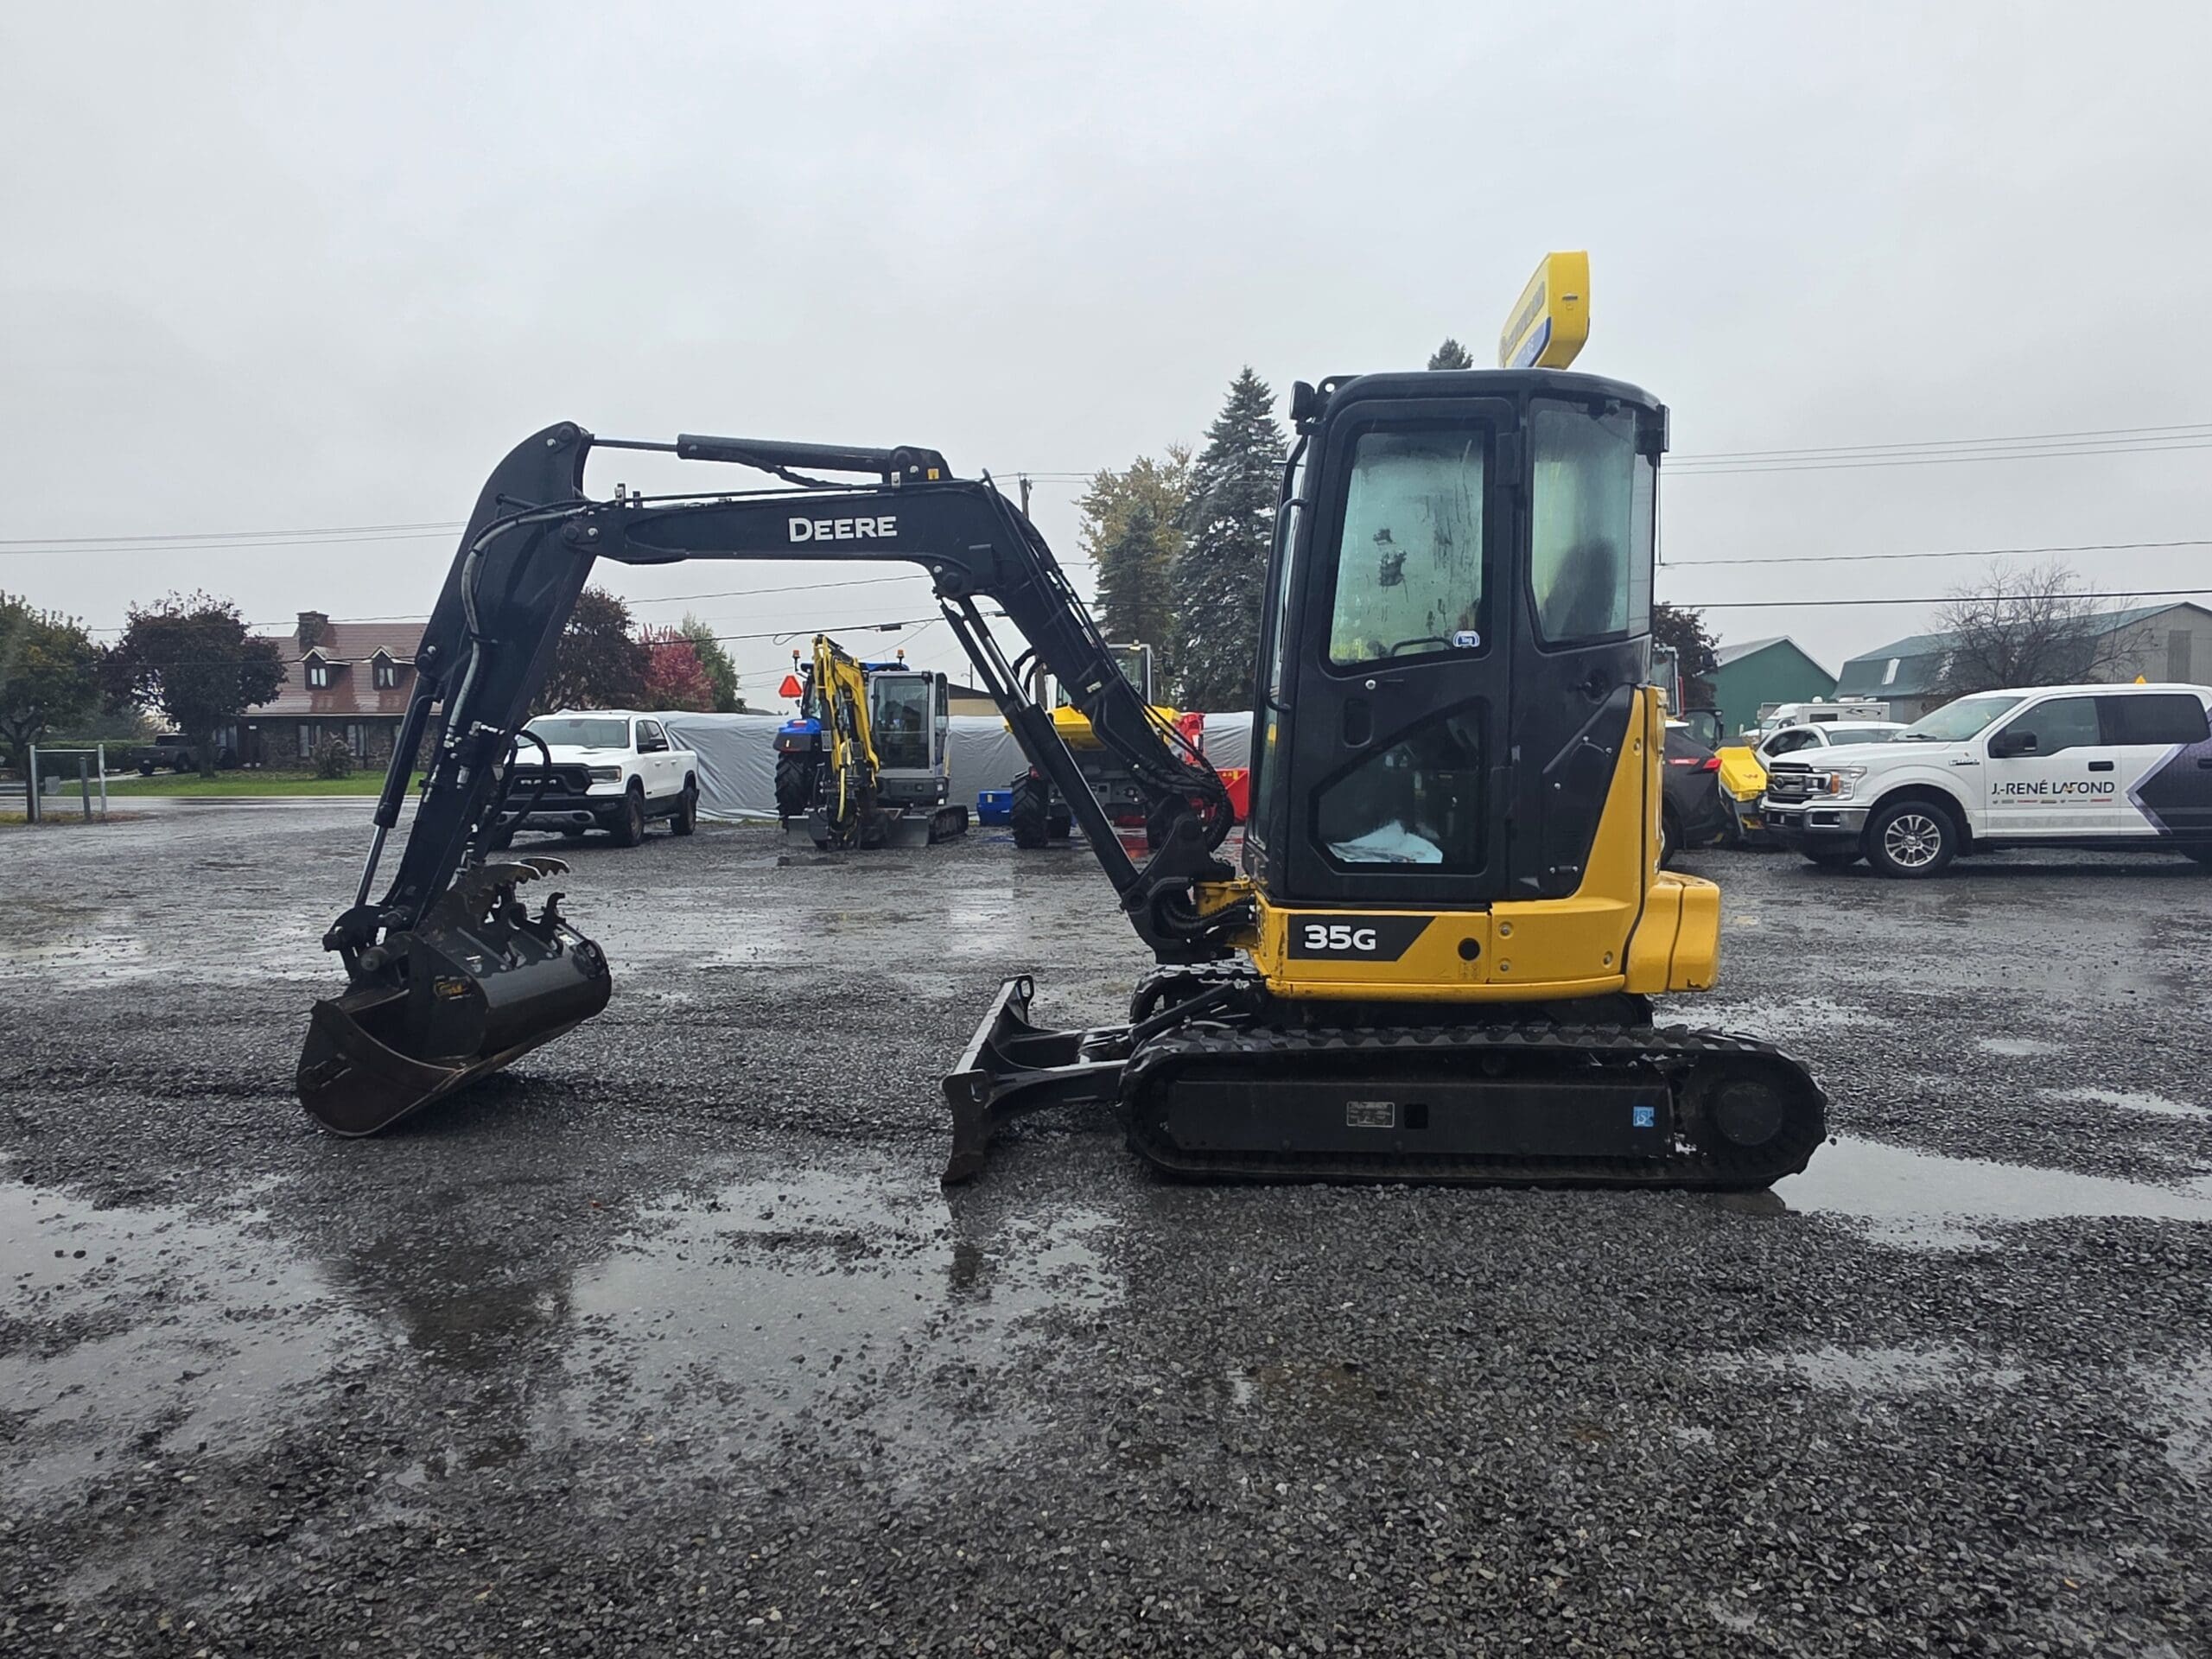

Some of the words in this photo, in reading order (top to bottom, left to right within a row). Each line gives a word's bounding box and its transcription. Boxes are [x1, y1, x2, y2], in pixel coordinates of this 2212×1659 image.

[788, 516, 898, 543] DEERE
[1991, 779, 2048, 795] J.-RENÉ
[2052, 781, 2115, 794] LAFOND
[1304, 925, 1376, 950] 35G
